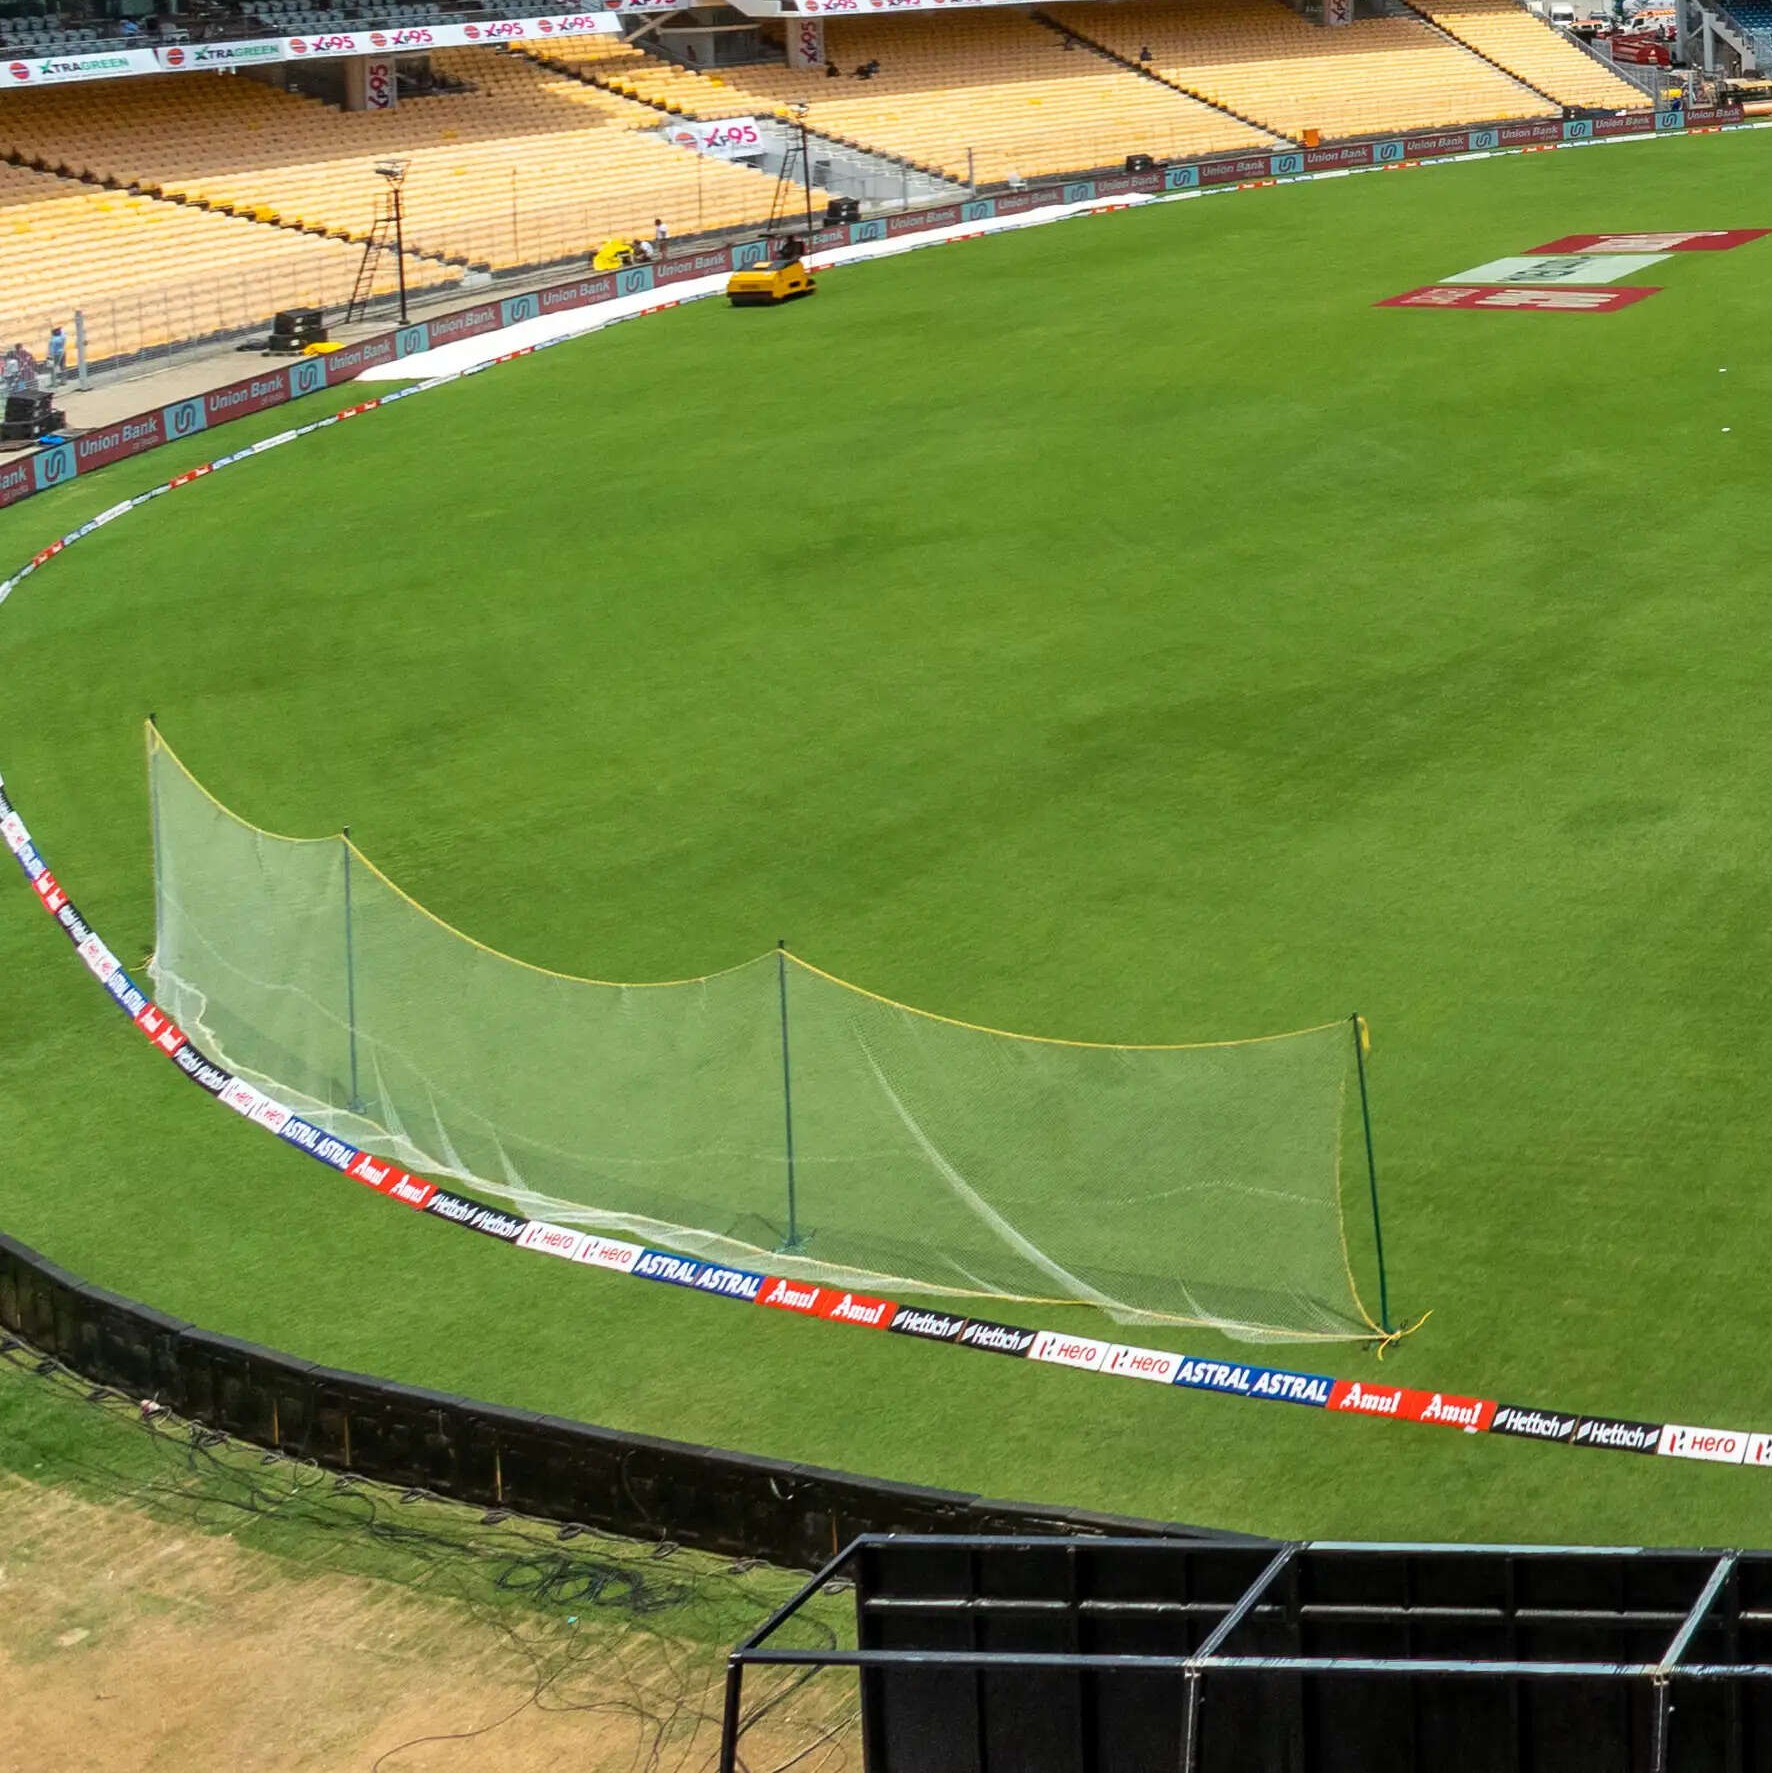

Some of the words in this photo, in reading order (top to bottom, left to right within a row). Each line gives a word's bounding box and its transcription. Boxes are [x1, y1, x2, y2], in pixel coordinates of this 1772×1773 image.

[39, 57, 130, 75] XTRAGREEN
[194, 45, 279, 61] XTRAGREEN
[1306, 151, 1338, 165] Union
[1340, 147, 1369, 162] Bank
[1407, 139, 1437, 153] Union
[1439, 135, 1467, 149] Bank
[658, 260, 691, 278] Union
[694, 253, 726, 269] Bank
[543, 289, 576, 307] Union
[580, 279, 611, 297] Bank
[330, 352, 361, 373] Union
[364, 340, 392, 359] Bank
[209, 388, 248, 411] Union
[251, 376, 284, 397] Bank
[80, 435, 120, 458] Union
[122, 418, 157, 442] Bank
[283, 1118, 316, 1148] ASTRAL
[316, 1139, 352, 1170] ASTRAL
[352, 1154, 386, 1186] Amul
[389, 1173, 426, 1205] Amul
[542, 1232, 574, 1250] Hero
[600, 1246, 633, 1265] Hero
[636, 1252, 697, 1285] ASTRAL
[698, 1266, 760, 1297] ASTRAL
[769, 1279, 819, 1309] Amul
[832, 1293, 885, 1325] Amul
[903, 1310, 950, 1337] Hettich
[973, 1323, 1021, 1350] Hettich
[1058, 1342, 1097, 1362] Hero
[1130, 1355, 1171, 1375] Hero
[1177, 1361, 1250, 1391] ASTRAL
[1251, 1373, 1329, 1403] ASTRAL
[1341, 1383, 1401, 1414] Amul
[1421, 1393, 1483, 1425] Amul
[1506, 1410, 1560, 1437] Hettich
[1589, 1422, 1646, 1448] Hettich
[1691, 1435, 1736, 1454] Hero
